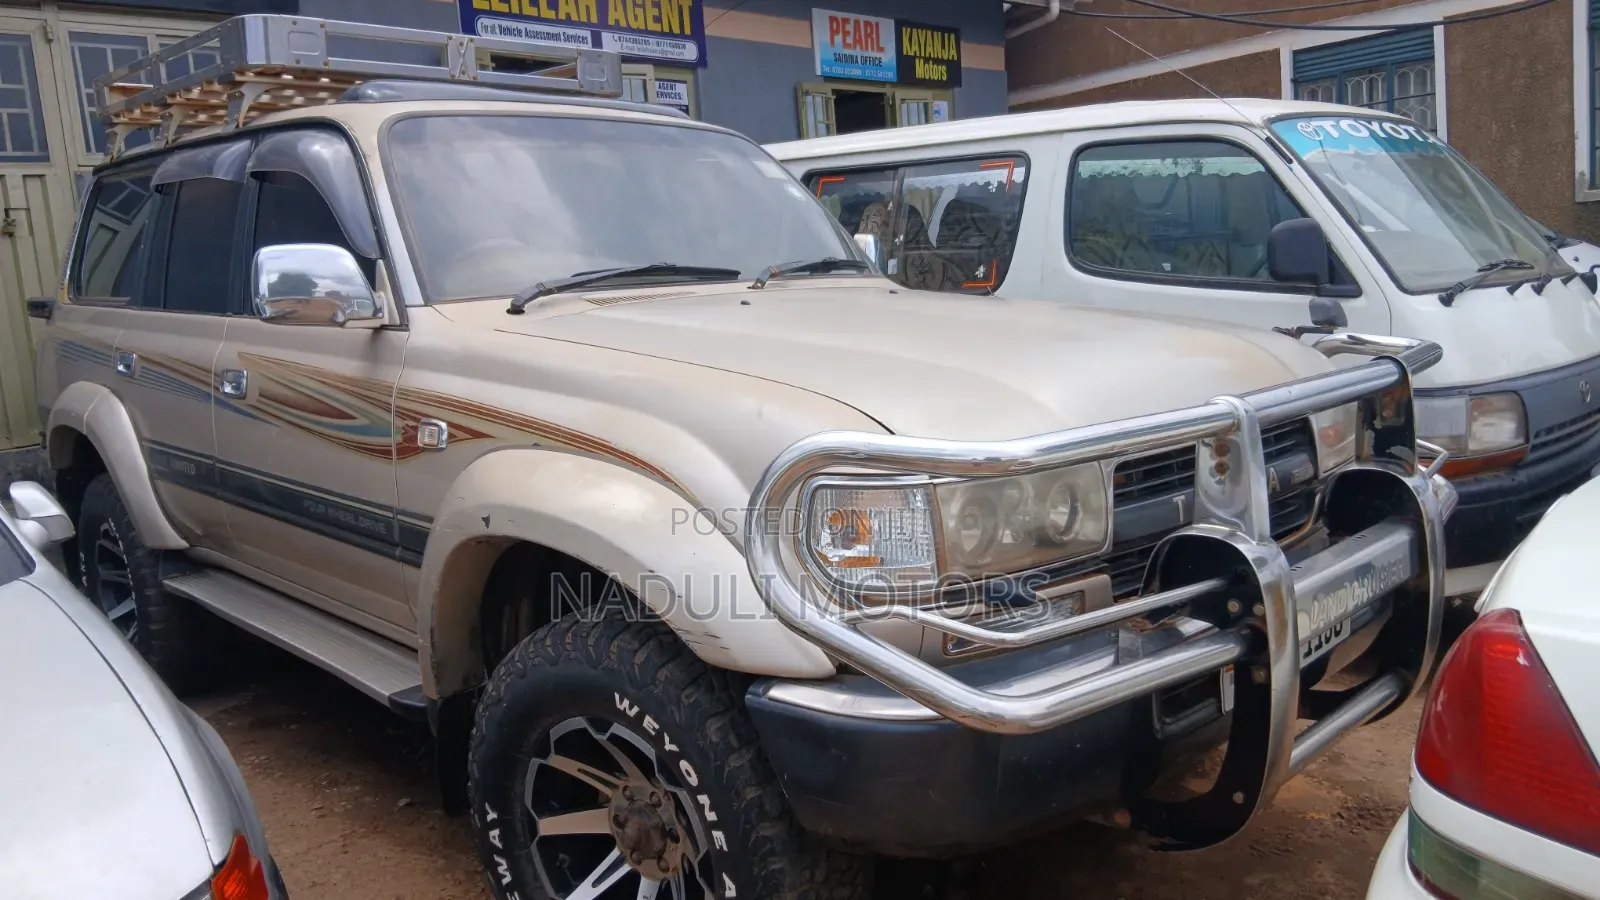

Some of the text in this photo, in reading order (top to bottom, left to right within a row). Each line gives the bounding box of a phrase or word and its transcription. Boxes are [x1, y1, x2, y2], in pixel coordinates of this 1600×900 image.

[473, 0, 693, 36] LLAH AGENT
[480, 22, 489, 34] For
[498, 24, 523, 38] Vehicle
[524, 28, 561, 42] Assessment
[562, 33, 589, 45] Services
[828, 15, 885, 53] PEARL
[902, 26, 957, 61] KAYANJA
[833, 52, 883, 67] SAIDINA OFFICE
[915, 58, 947, 82] Motors
[656, 91, 684, 100] ERVICES:
[657, 82, 677, 92] AGENT
[327, 507, 356, 525] WHEEL
[359, 515, 387, 534] DRIVE
[613, 691, 728, 852] WEYONE
